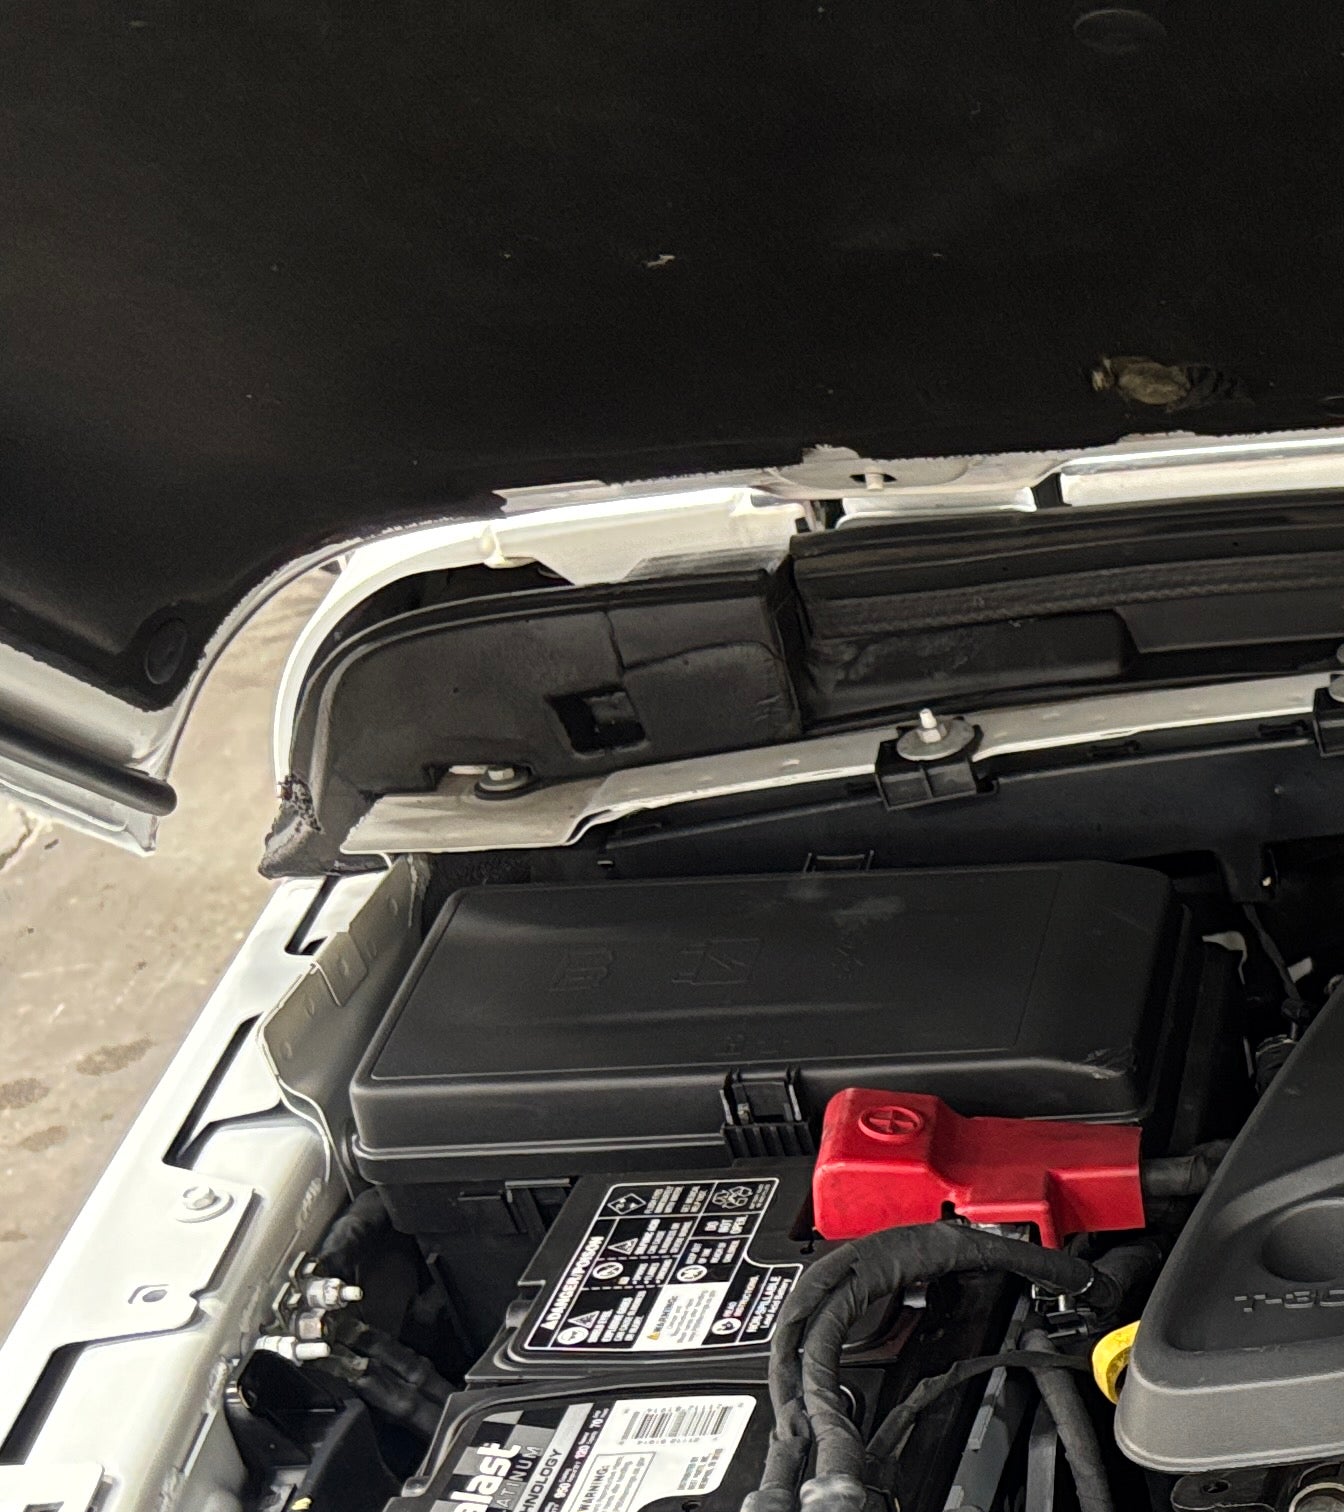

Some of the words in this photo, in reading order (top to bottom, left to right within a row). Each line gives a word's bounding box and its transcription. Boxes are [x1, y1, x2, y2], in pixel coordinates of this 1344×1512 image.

[574, 1444, 591, 1459] 120
[590, 1417, 605, 1428] 70
[578, 1464, 610, 1512] WARNING:
